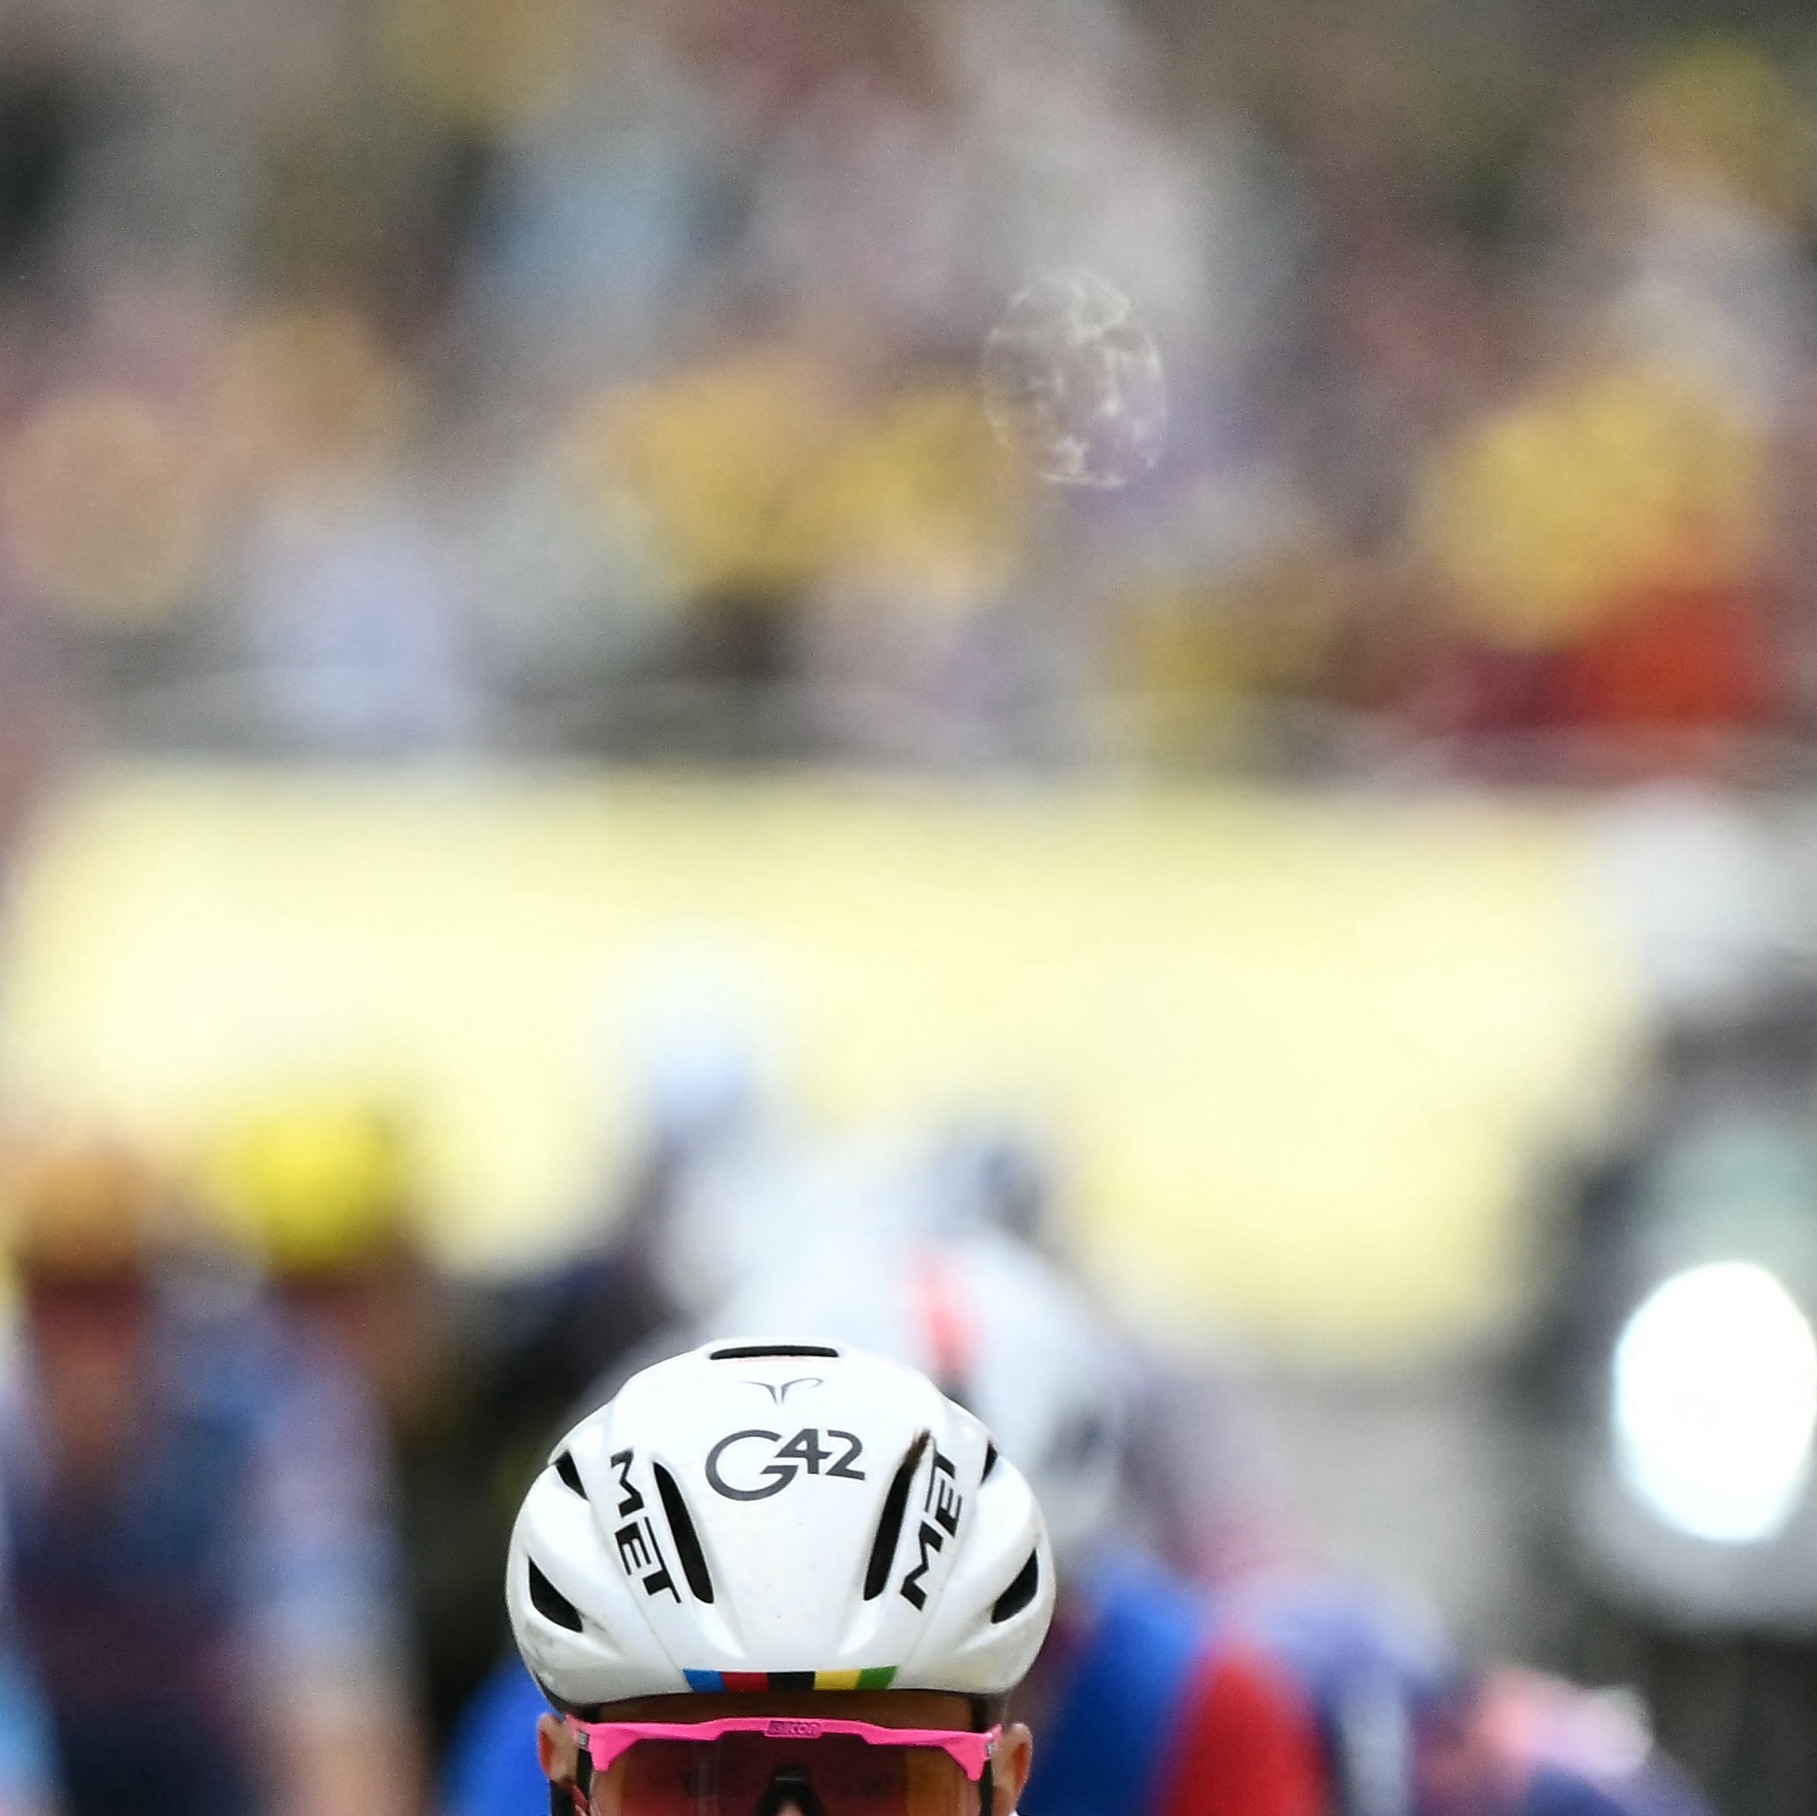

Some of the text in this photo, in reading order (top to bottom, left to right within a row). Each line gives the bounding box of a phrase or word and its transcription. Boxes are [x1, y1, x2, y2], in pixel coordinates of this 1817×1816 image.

[610, 1447, 682, 1604] MET
[704, 1428, 867, 1502] G42
[899, 1437, 965, 1611] MET
